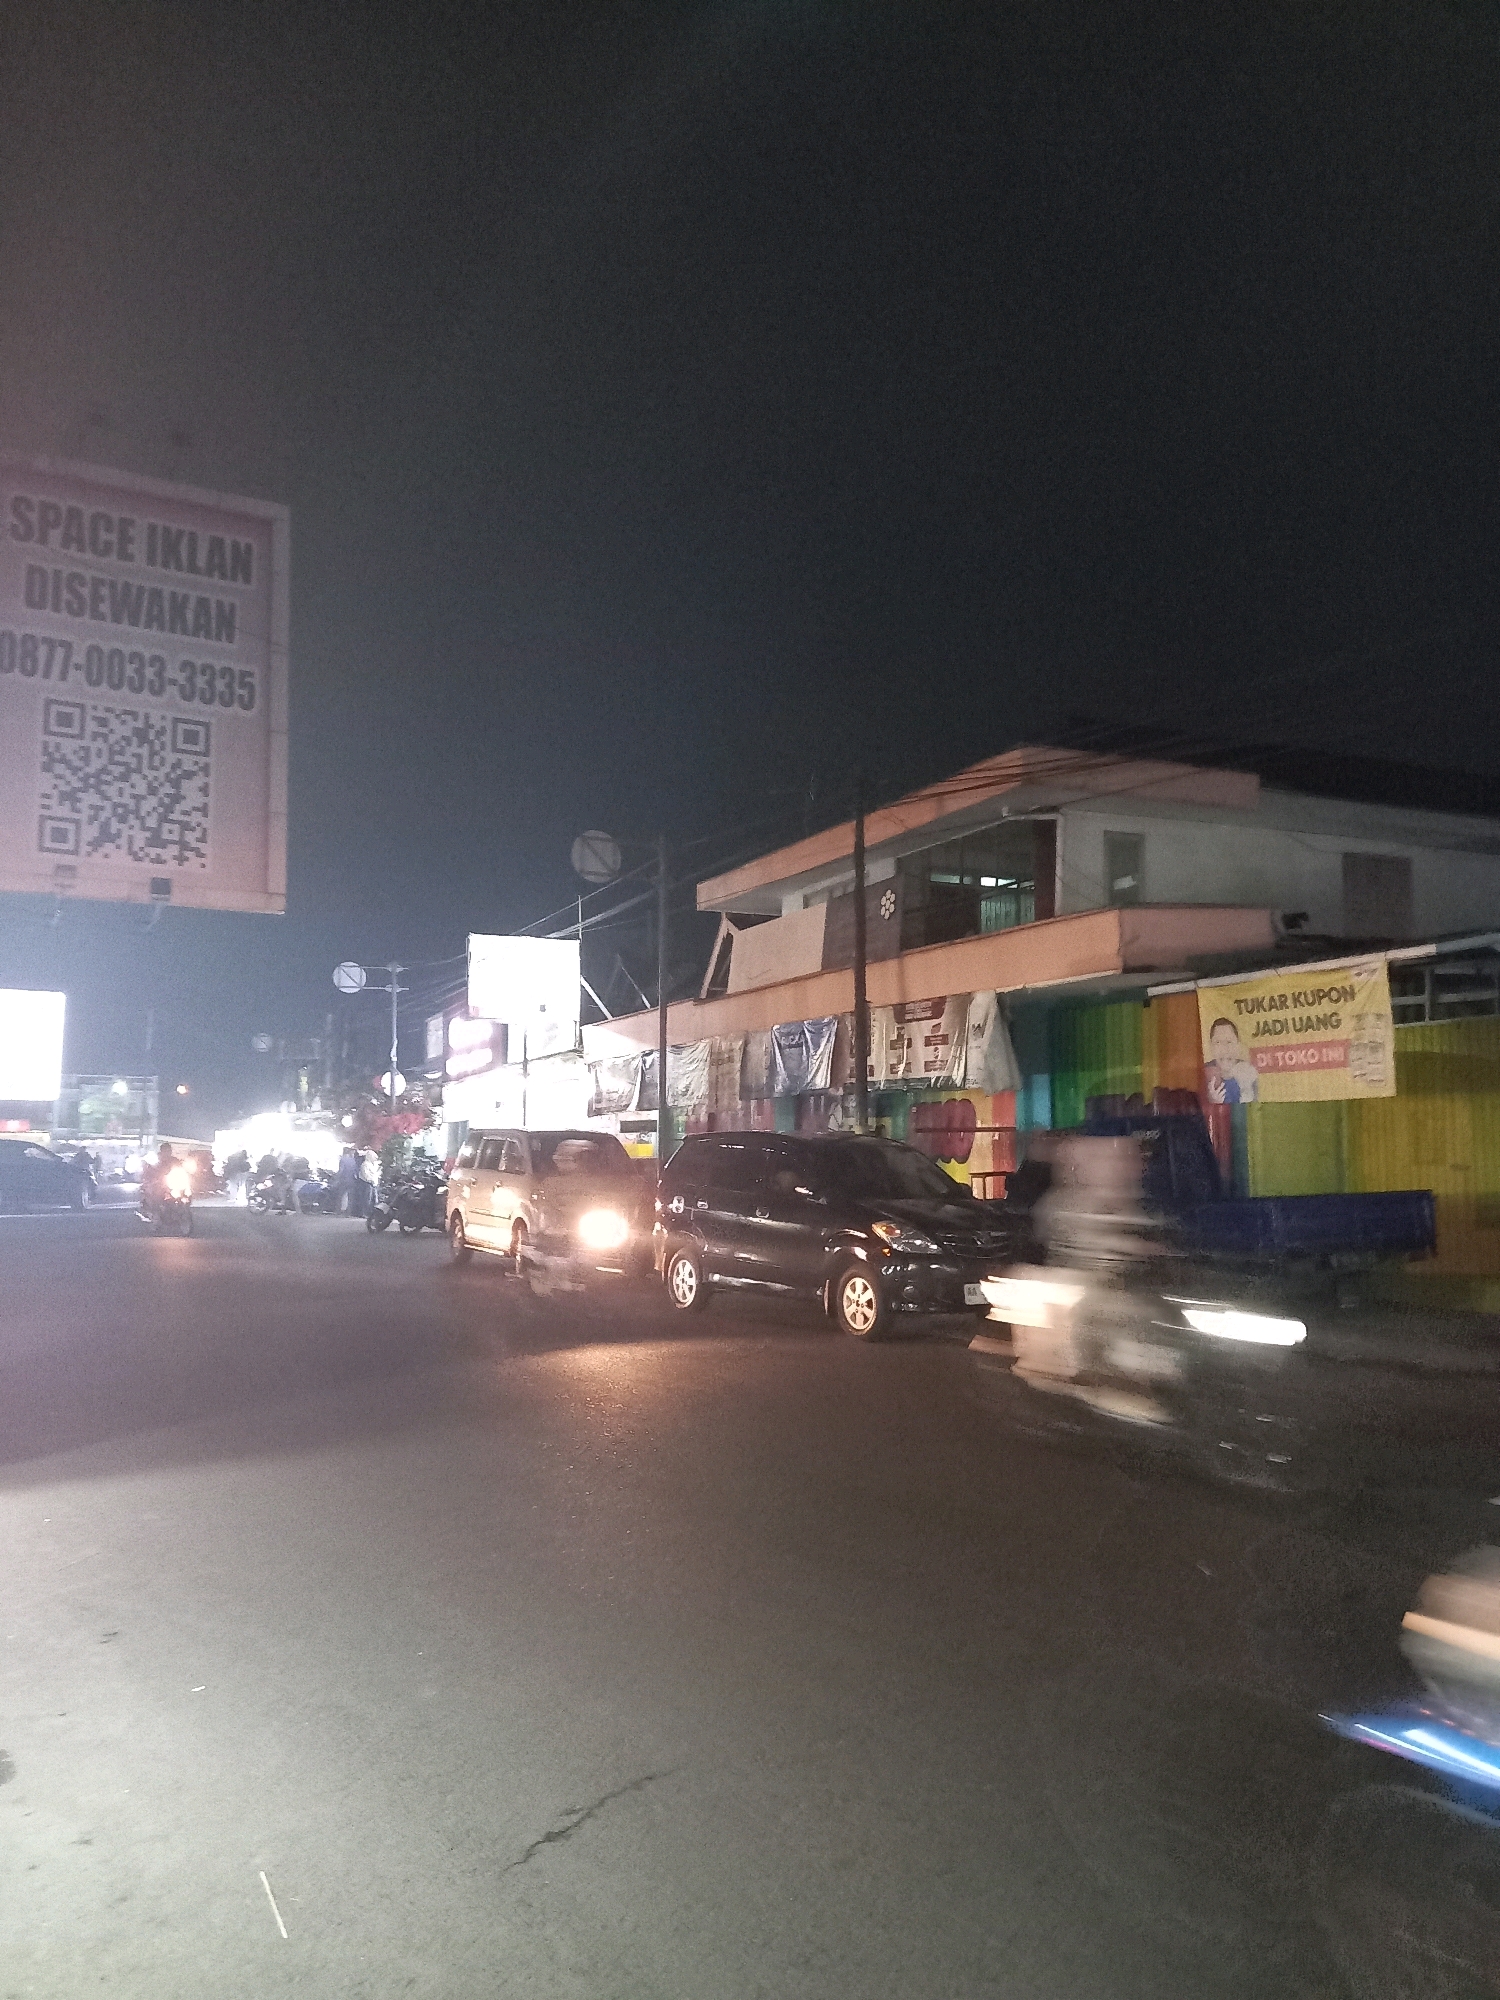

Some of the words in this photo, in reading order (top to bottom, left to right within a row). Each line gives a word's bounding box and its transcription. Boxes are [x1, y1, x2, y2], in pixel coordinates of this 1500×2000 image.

[10, 496, 135, 562] SPACE
[147, 521, 253, 585] IKLAN
[25, 563, 237, 644] DISEWAKAN
[0, 629, 256, 711] 0877-0033-3335
[1234, 993, 1289, 1015] TUKAR
[1292, 985, 1356, 1008] KUPON
[1252, 1018, 1290, 1038] JADI
[1292, 1012, 1342, 1034] UANG
[1256, 1052, 1272, 1068] DI
[1274, 1048, 1319, 1067] TOKO
